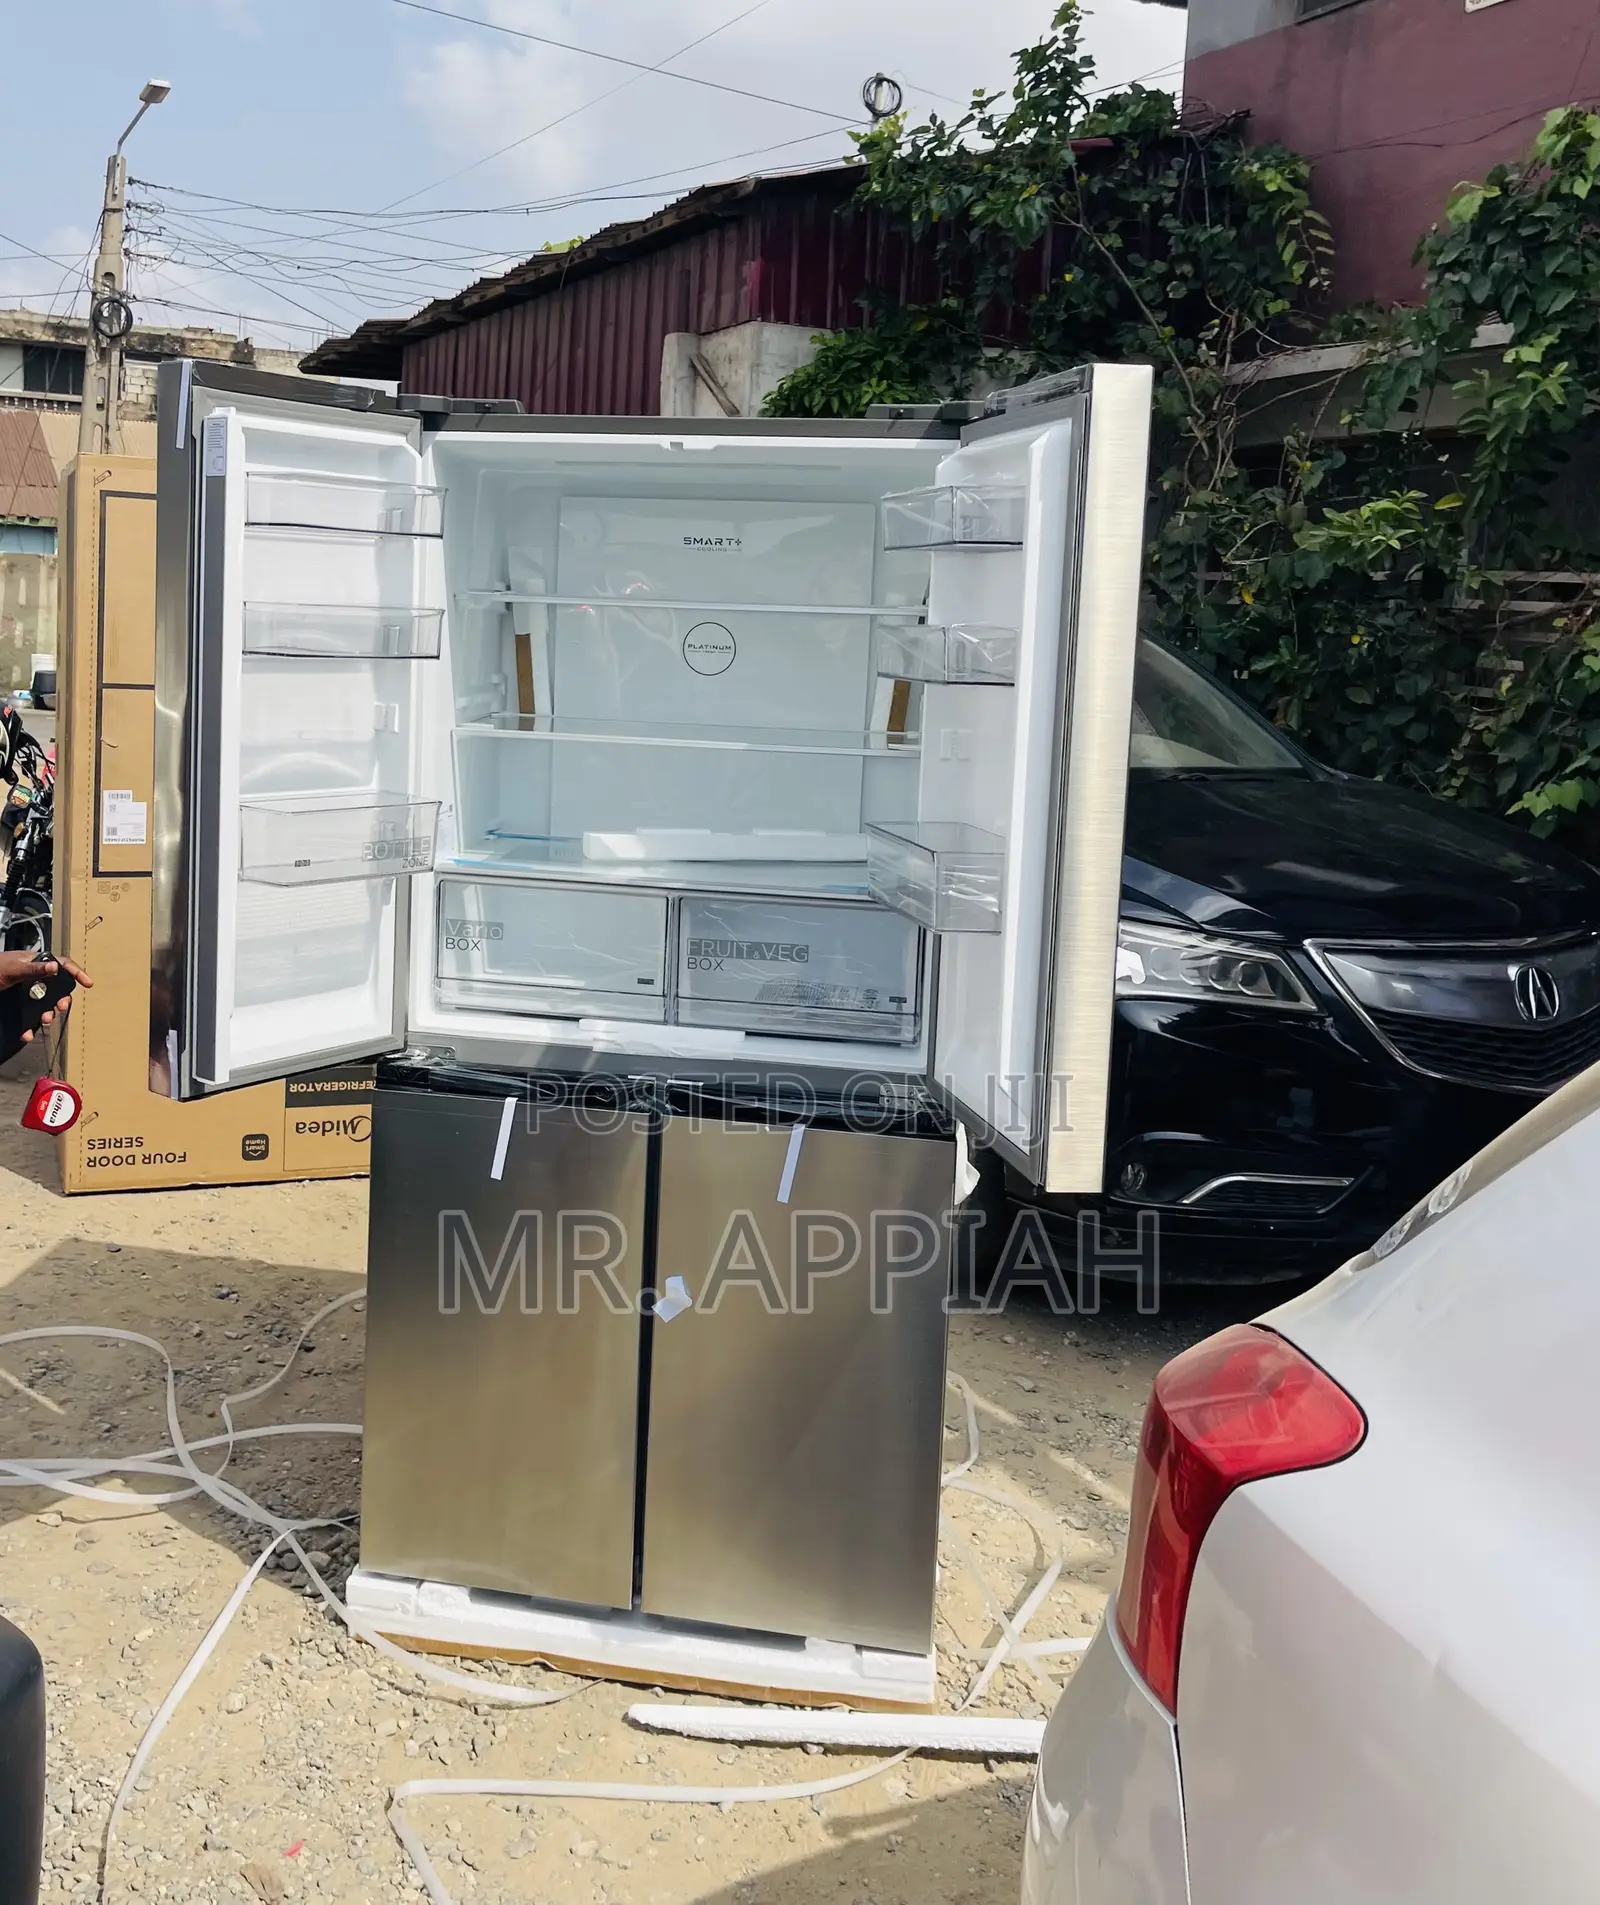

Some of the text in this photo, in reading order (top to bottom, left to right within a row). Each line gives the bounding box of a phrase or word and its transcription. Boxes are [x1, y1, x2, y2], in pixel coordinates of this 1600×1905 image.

[687, 643, 732, 651] PLATINUM
[363, 837, 431, 860] BOTTLE
[402, 856, 429, 869] ZONE
[446, 919, 503, 940] Vario
[445, 937, 481, 952] BOX
[687, 956, 725, 972] BOX
[289, 1080, 376, 1093] EFRIGERATOR
[295, 1115, 372, 1142] Midea
[87, 1136, 144, 1150] SERIES
[86, 1151, 187, 1168] FOUR DOOR
